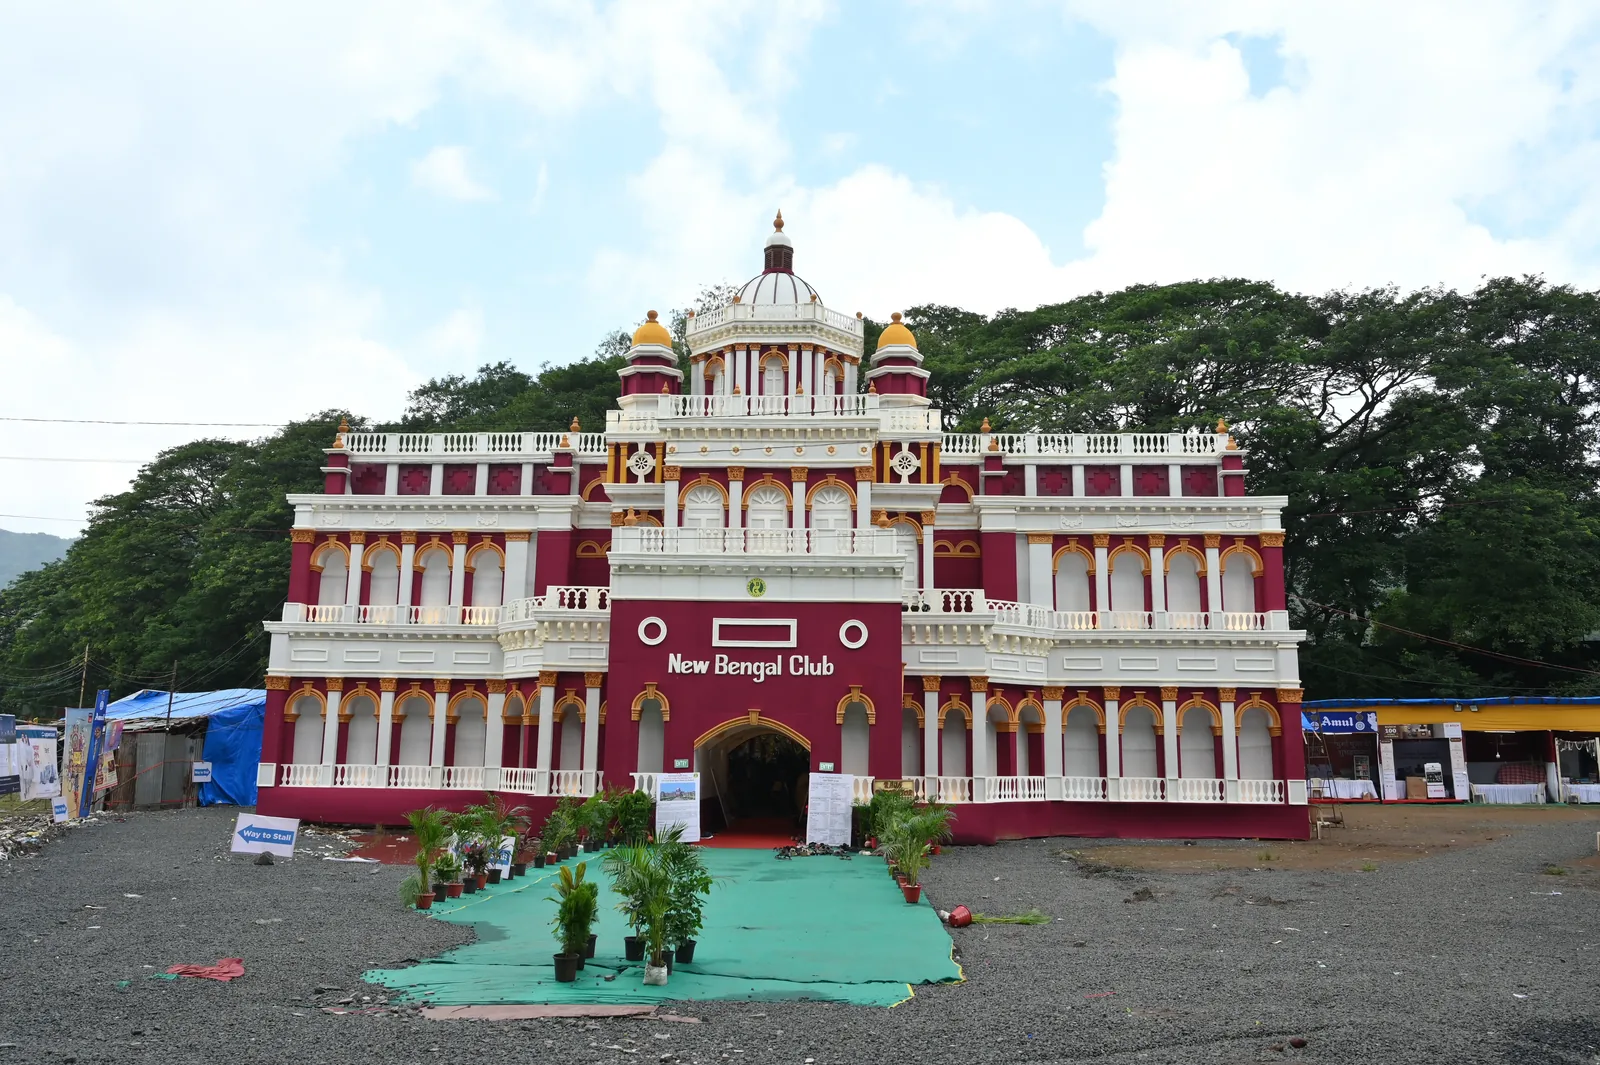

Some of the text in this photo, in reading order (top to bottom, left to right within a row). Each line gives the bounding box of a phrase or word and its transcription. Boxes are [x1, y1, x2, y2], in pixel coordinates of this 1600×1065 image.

[668, 653, 834, 683] New Bengal Club
[1321, 716, 1354, 727] Amul
[243, 830, 261, 839] Way
[273, 833, 292, 841] Stall
